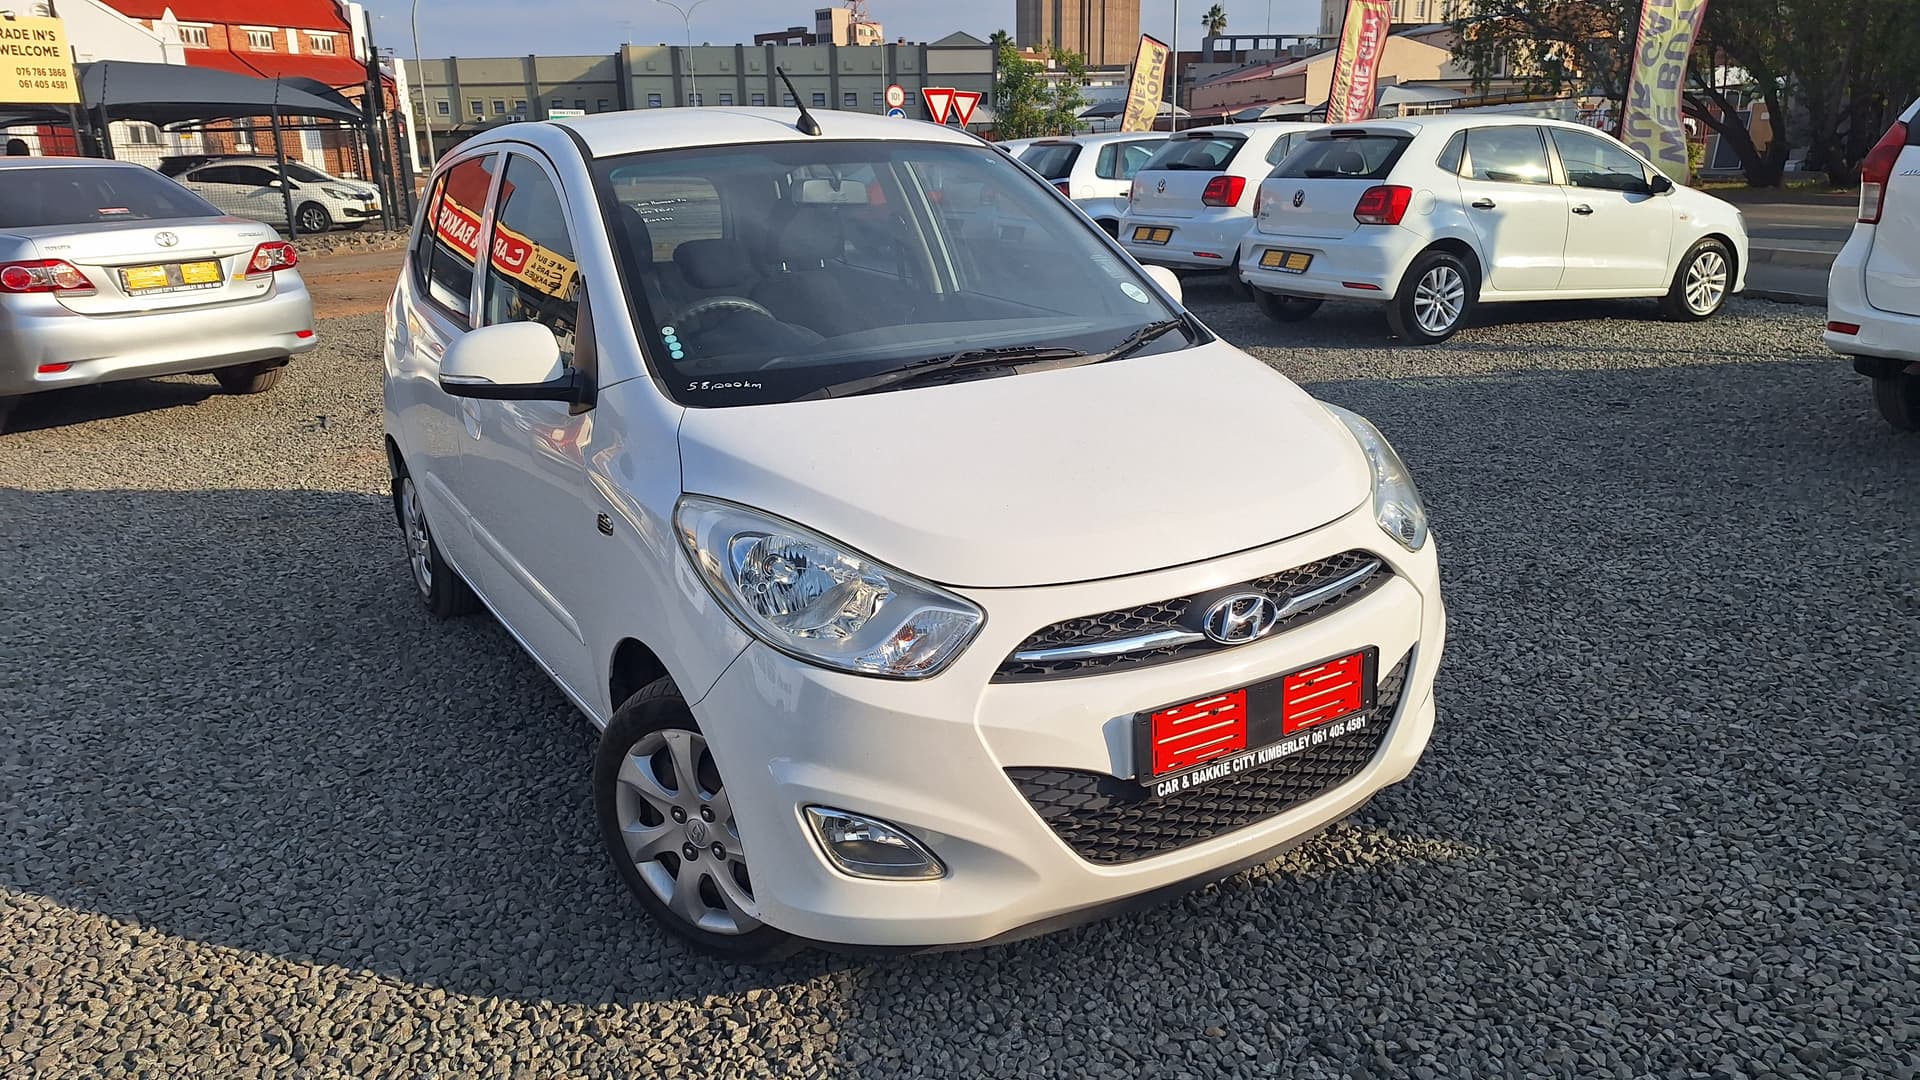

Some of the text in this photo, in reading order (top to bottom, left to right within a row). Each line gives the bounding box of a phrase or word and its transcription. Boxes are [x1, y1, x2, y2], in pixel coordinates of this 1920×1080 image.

[32, 29, 56, 41] IN'S
[0, 45, 60, 57] WELCOME
[16, 67, 31, 76] 076
[32, 67, 47, 77] 786
[19, 79, 68, 89] 061 405 4581
[1157, 716, 1366, 797] CAR & BAKKIE CITY KIMBERLEY 061 405 4581
